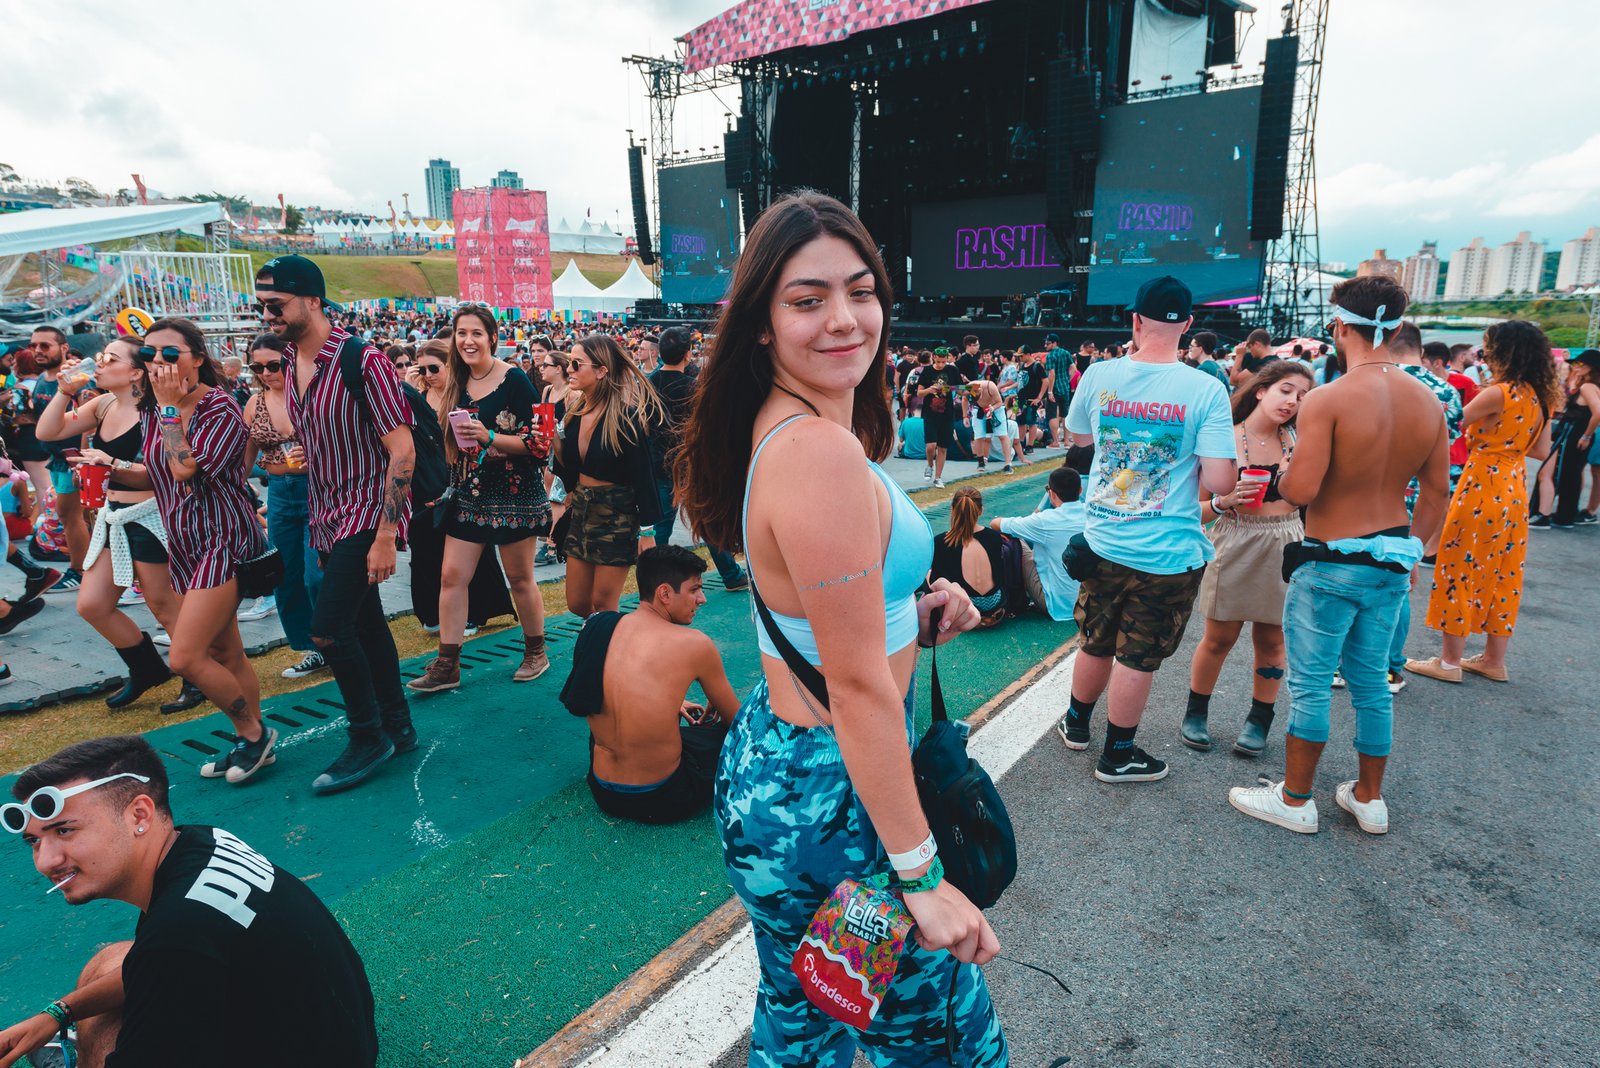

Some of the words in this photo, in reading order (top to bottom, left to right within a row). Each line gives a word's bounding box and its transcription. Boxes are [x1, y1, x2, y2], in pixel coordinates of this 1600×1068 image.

[1118, 202, 1193, 231] RASHID
[672, 233, 706, 254] RASHID
[1100, 389, 1118, 407] Eri
[1102, 400, 1187, 423] JOHNSON
[1098, 506, 1120, 517] IMPORTA
[847, 925, 879, 944] BRASIL
[810, 970, 862, 1015] bradesco
